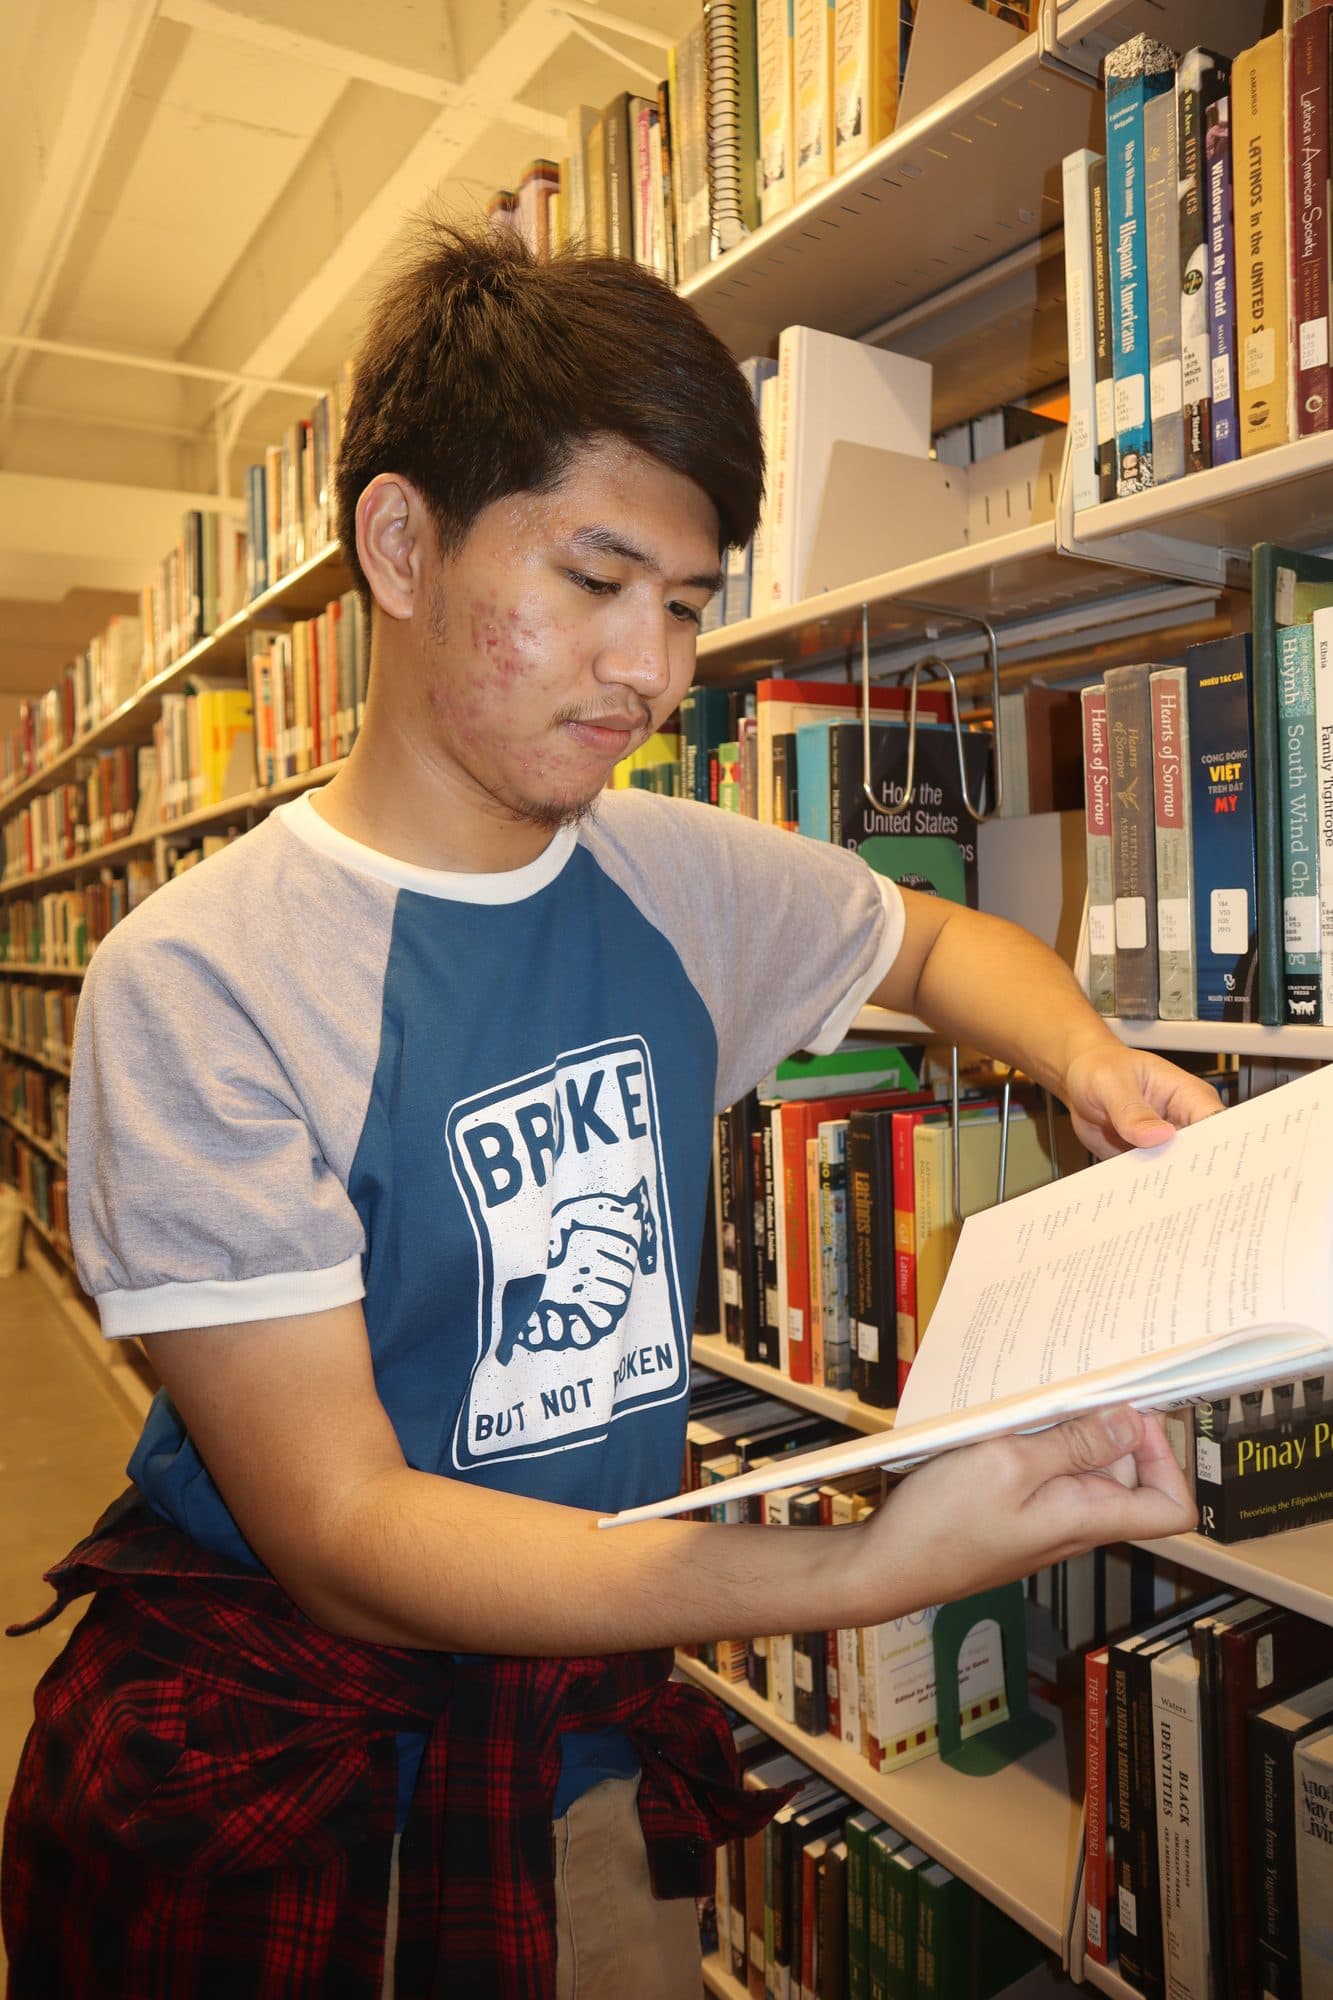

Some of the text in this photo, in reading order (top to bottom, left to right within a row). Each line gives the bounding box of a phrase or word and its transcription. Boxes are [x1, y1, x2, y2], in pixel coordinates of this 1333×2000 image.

[1211, 160, 1224, 223] Windows
[1248, 135, 1262, 208] LATINOS
[1300, 87, 1322, 258] Latinos in American Society
[1251, 212, 1262, 229] in
[1117, 219, 1137, 282] Hispanic
[1251, 230, 1263, 256] the
[1212, 256, 1225, 275] My
[1214, 276, 1227, 317] World
[1252, 261, 1264, 320] UNITED
[1120, 283, 1138, 354] Americans
[1319, 641, 1328, 669] Kibria
[1091, 709, 1105, 753] Hearts
[1112, 721, 1127, 736] of
[1128, 728, 1139, 769] Hearts
[1321, 726, 1333, 771] Family
[1090, 754, 1108, 770] of
[1158, 694, 1179, 818] Hearts of Sorrow
[1208, 762, 1241, 783] VIỆT
[919, 783, 943, 806] the
[1093, 775, 1108, 826] Sorrow
[1287, 724, 1309, 854] South Wind
[863, 810, 959, 834] United States
[856, 1171, 873, 1235] Latinos
[899, 1256, 910, 1294] Latinos
[475, 1401, 525, 1442] BUT
[539, 1378, 594, 1420] NOT
[1237, 1436, 1307, 1477] Pinay
[1239, 1503, 1277, 1520] Theorizing
[1278, 1500, 1290, 1510] the
[1160, 1696, 1187, 1714] Waters
[1088, 1677, 1099, 1857] THE WEST INDIAN DIASPORA
[1114, 1670, 1131, 1832] WEST INDIAN IMMIGRANTS
[1160, 1720, 1173, 1818] IDENTITIES
[1179, 1770, 1190, 1827] BLACK
[1264, 1752, 1277, 1825] Americans
[1265, 1827, 1278, 1860] from
